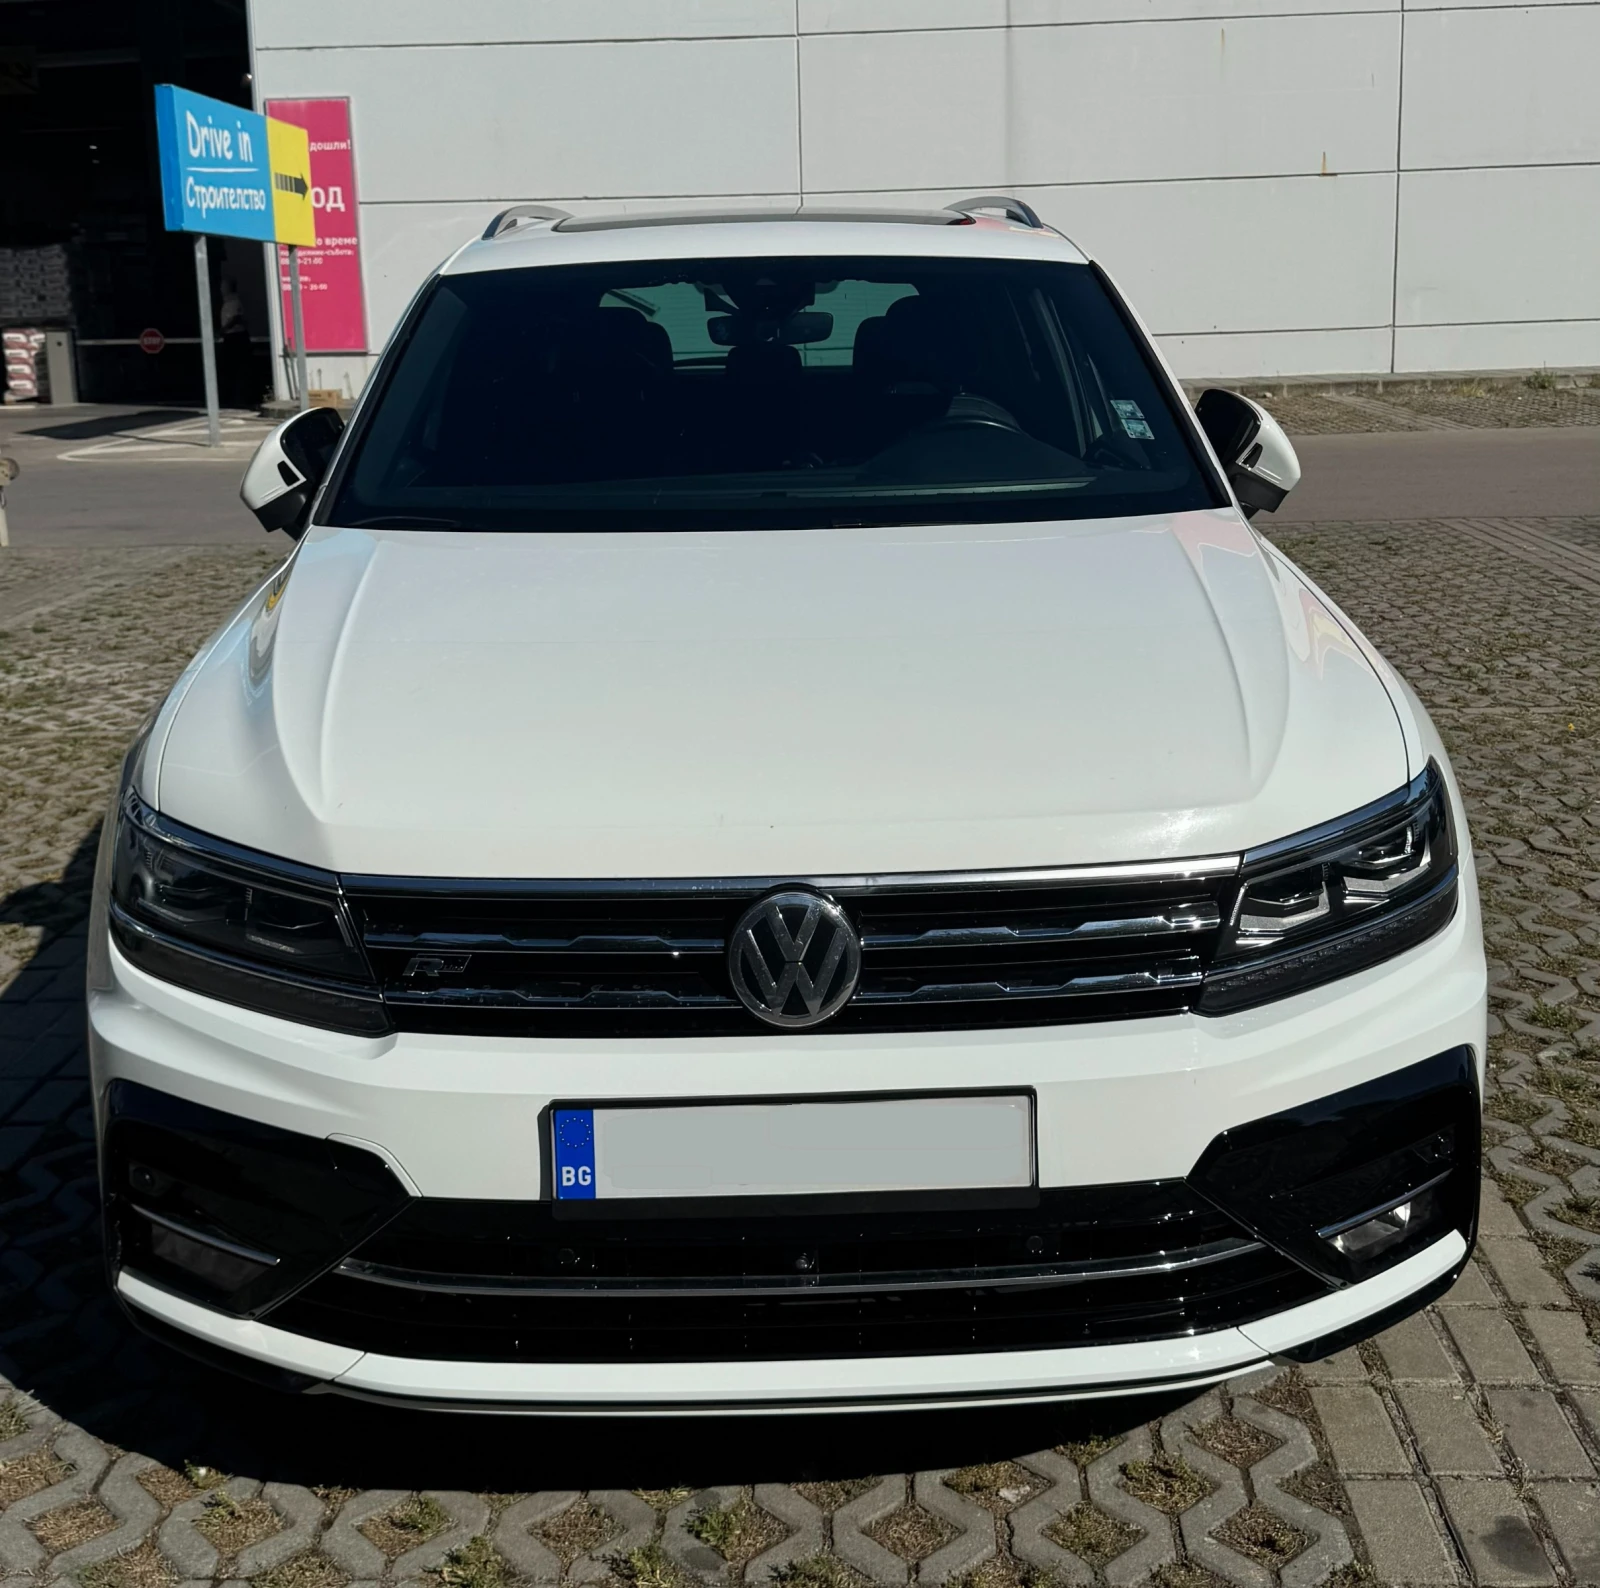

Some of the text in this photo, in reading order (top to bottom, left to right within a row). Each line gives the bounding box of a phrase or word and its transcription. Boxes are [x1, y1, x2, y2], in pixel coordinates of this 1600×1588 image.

[186, 110, 253, 163] Drive in
[309, 139, 351, 152] дошли!
[186, 176, 266, 219] Строителство
[311, 186, 346, 213] ОД
[561, 1165, 592, 1187] BG
